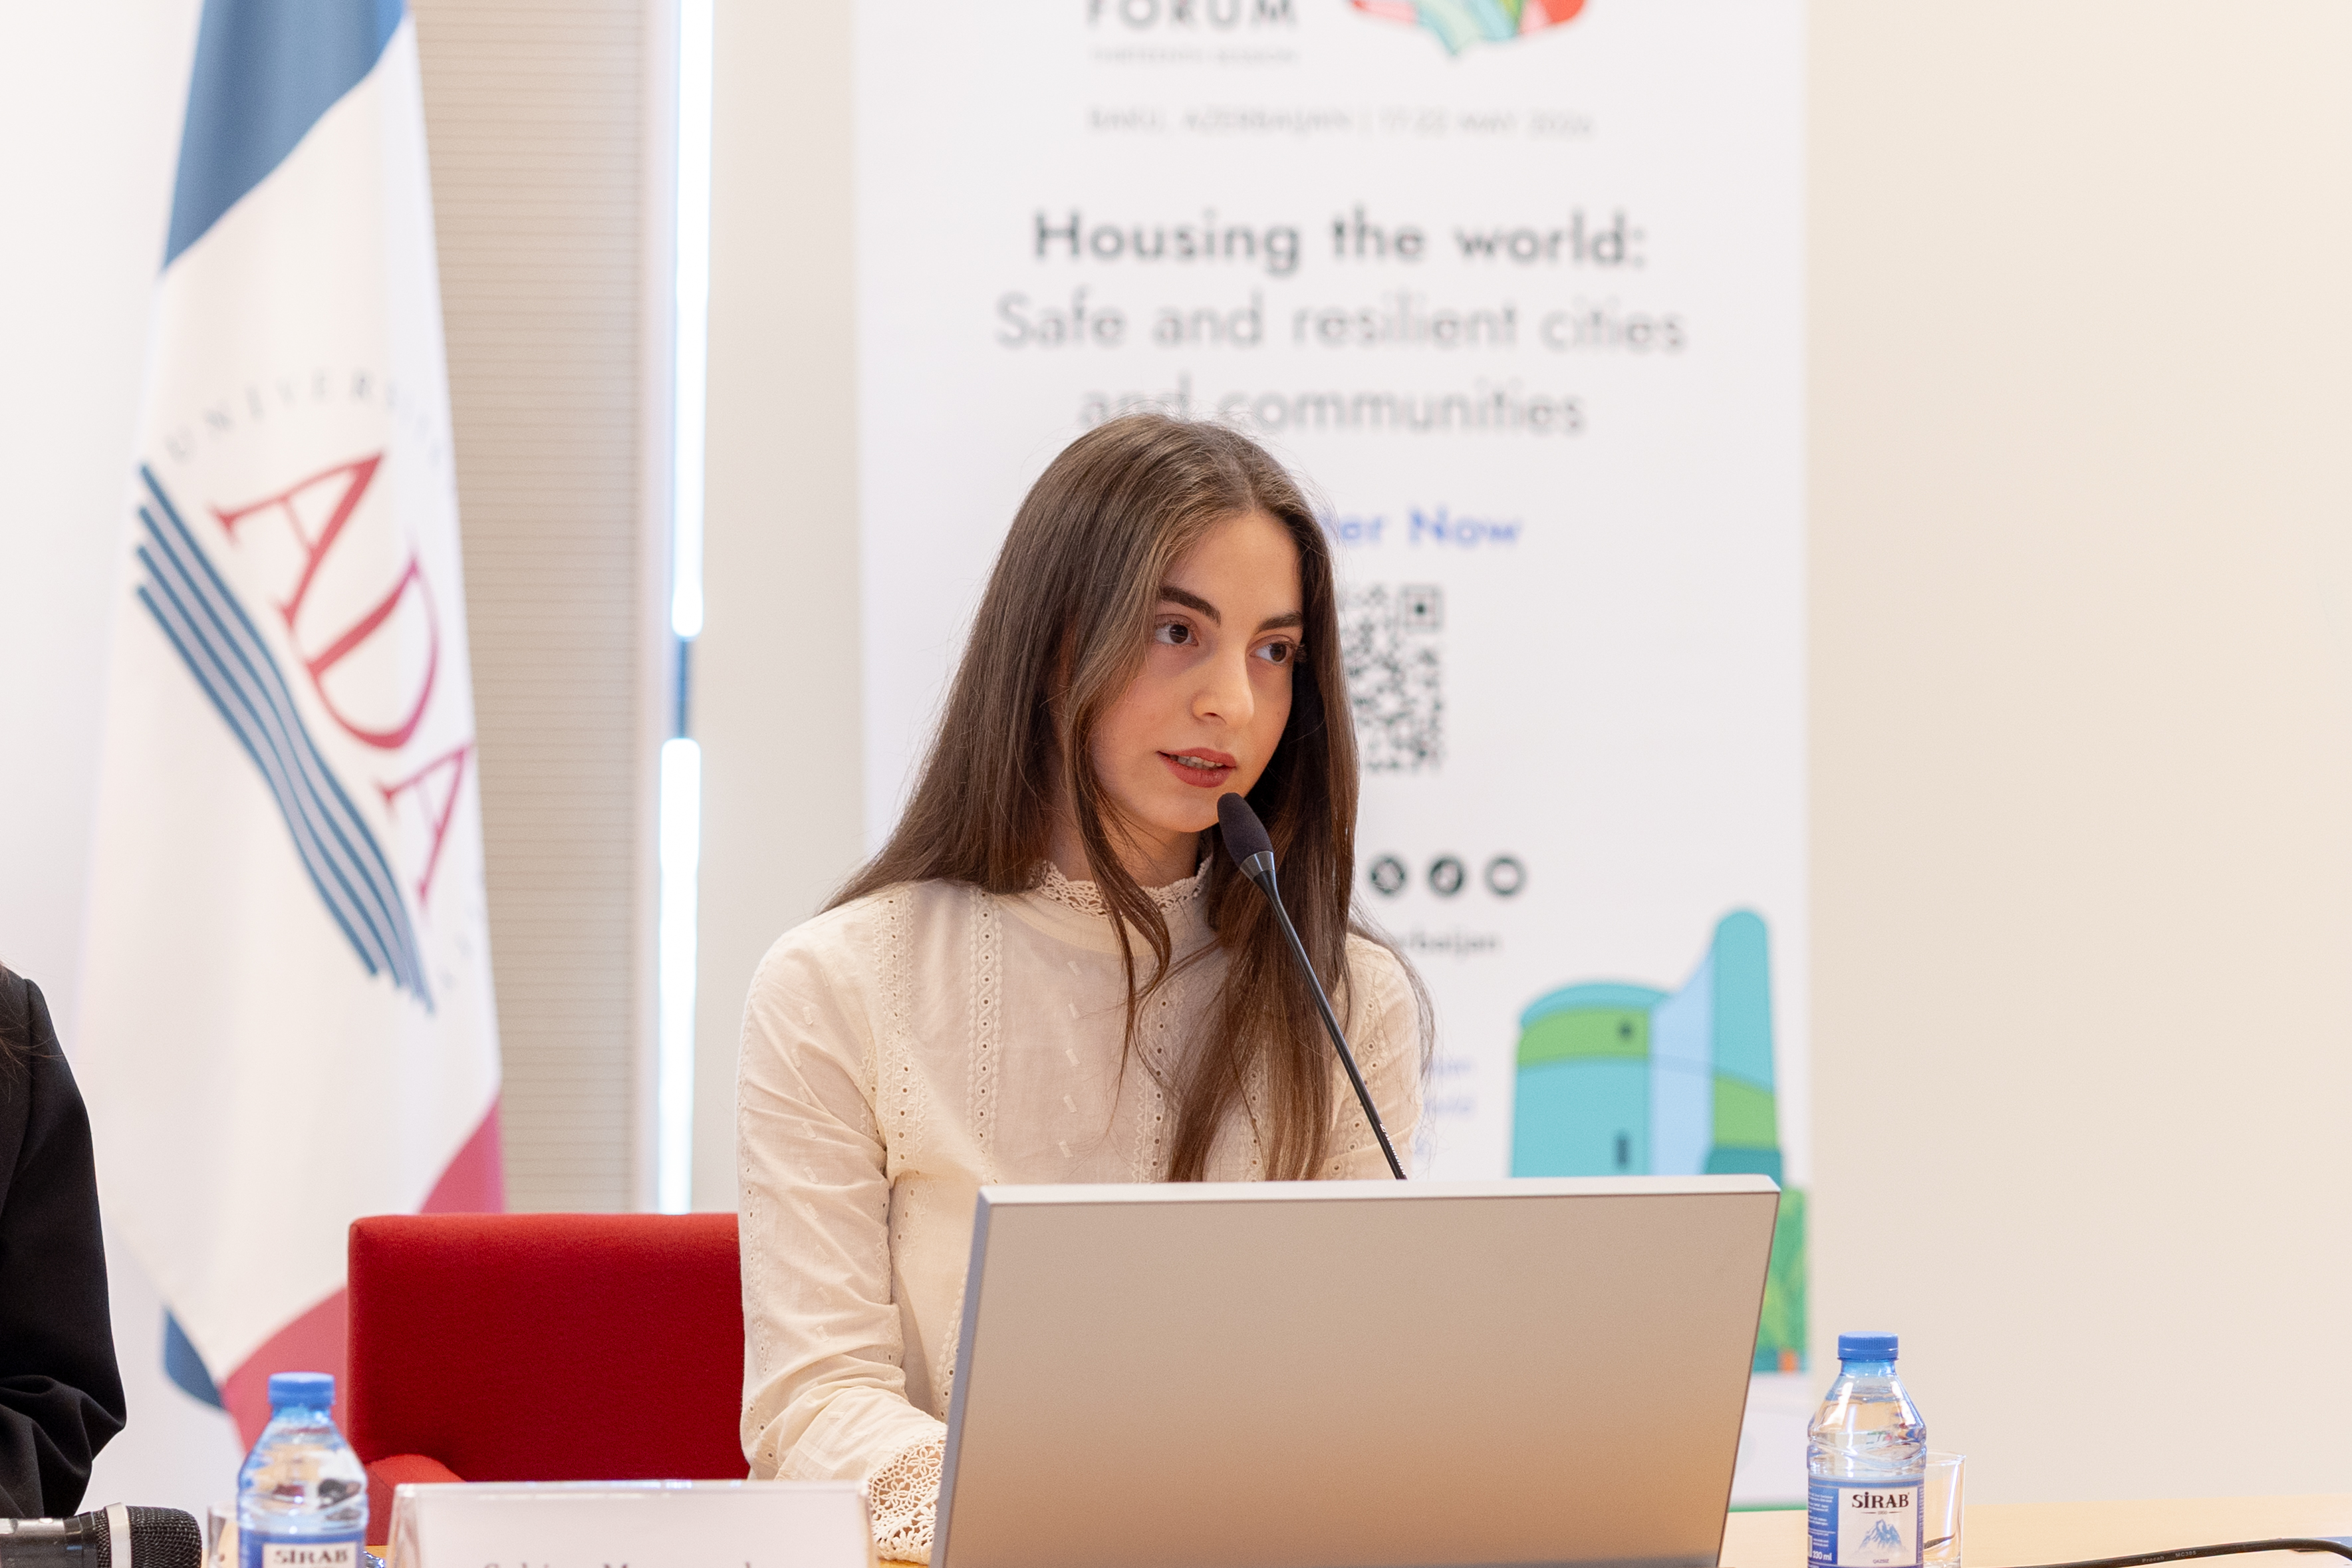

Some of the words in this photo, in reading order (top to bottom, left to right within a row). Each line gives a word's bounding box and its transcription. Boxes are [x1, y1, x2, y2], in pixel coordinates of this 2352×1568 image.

[1087, 0, 1298, 31] FORUM
[1033, 208, 1301, 276] Housing
[1331, 203, 1427, 262] the
[1454, 209, 1645, 269] world:
[996, 286, 1128, 349] Safe
[1152, 287, 1264, 347] and
[1292, 290, 1519, 349] resilient
[1540, 295, 1688, 353] cities
[1218, 378, 1585, 435] communities
[1408, 506, 1523, 549] Now
[207, 451, 475, 915] ADA
[1852, 1492, 1909, 1508] SİRAB
[1823, 1552, 1832, 1561] ml
